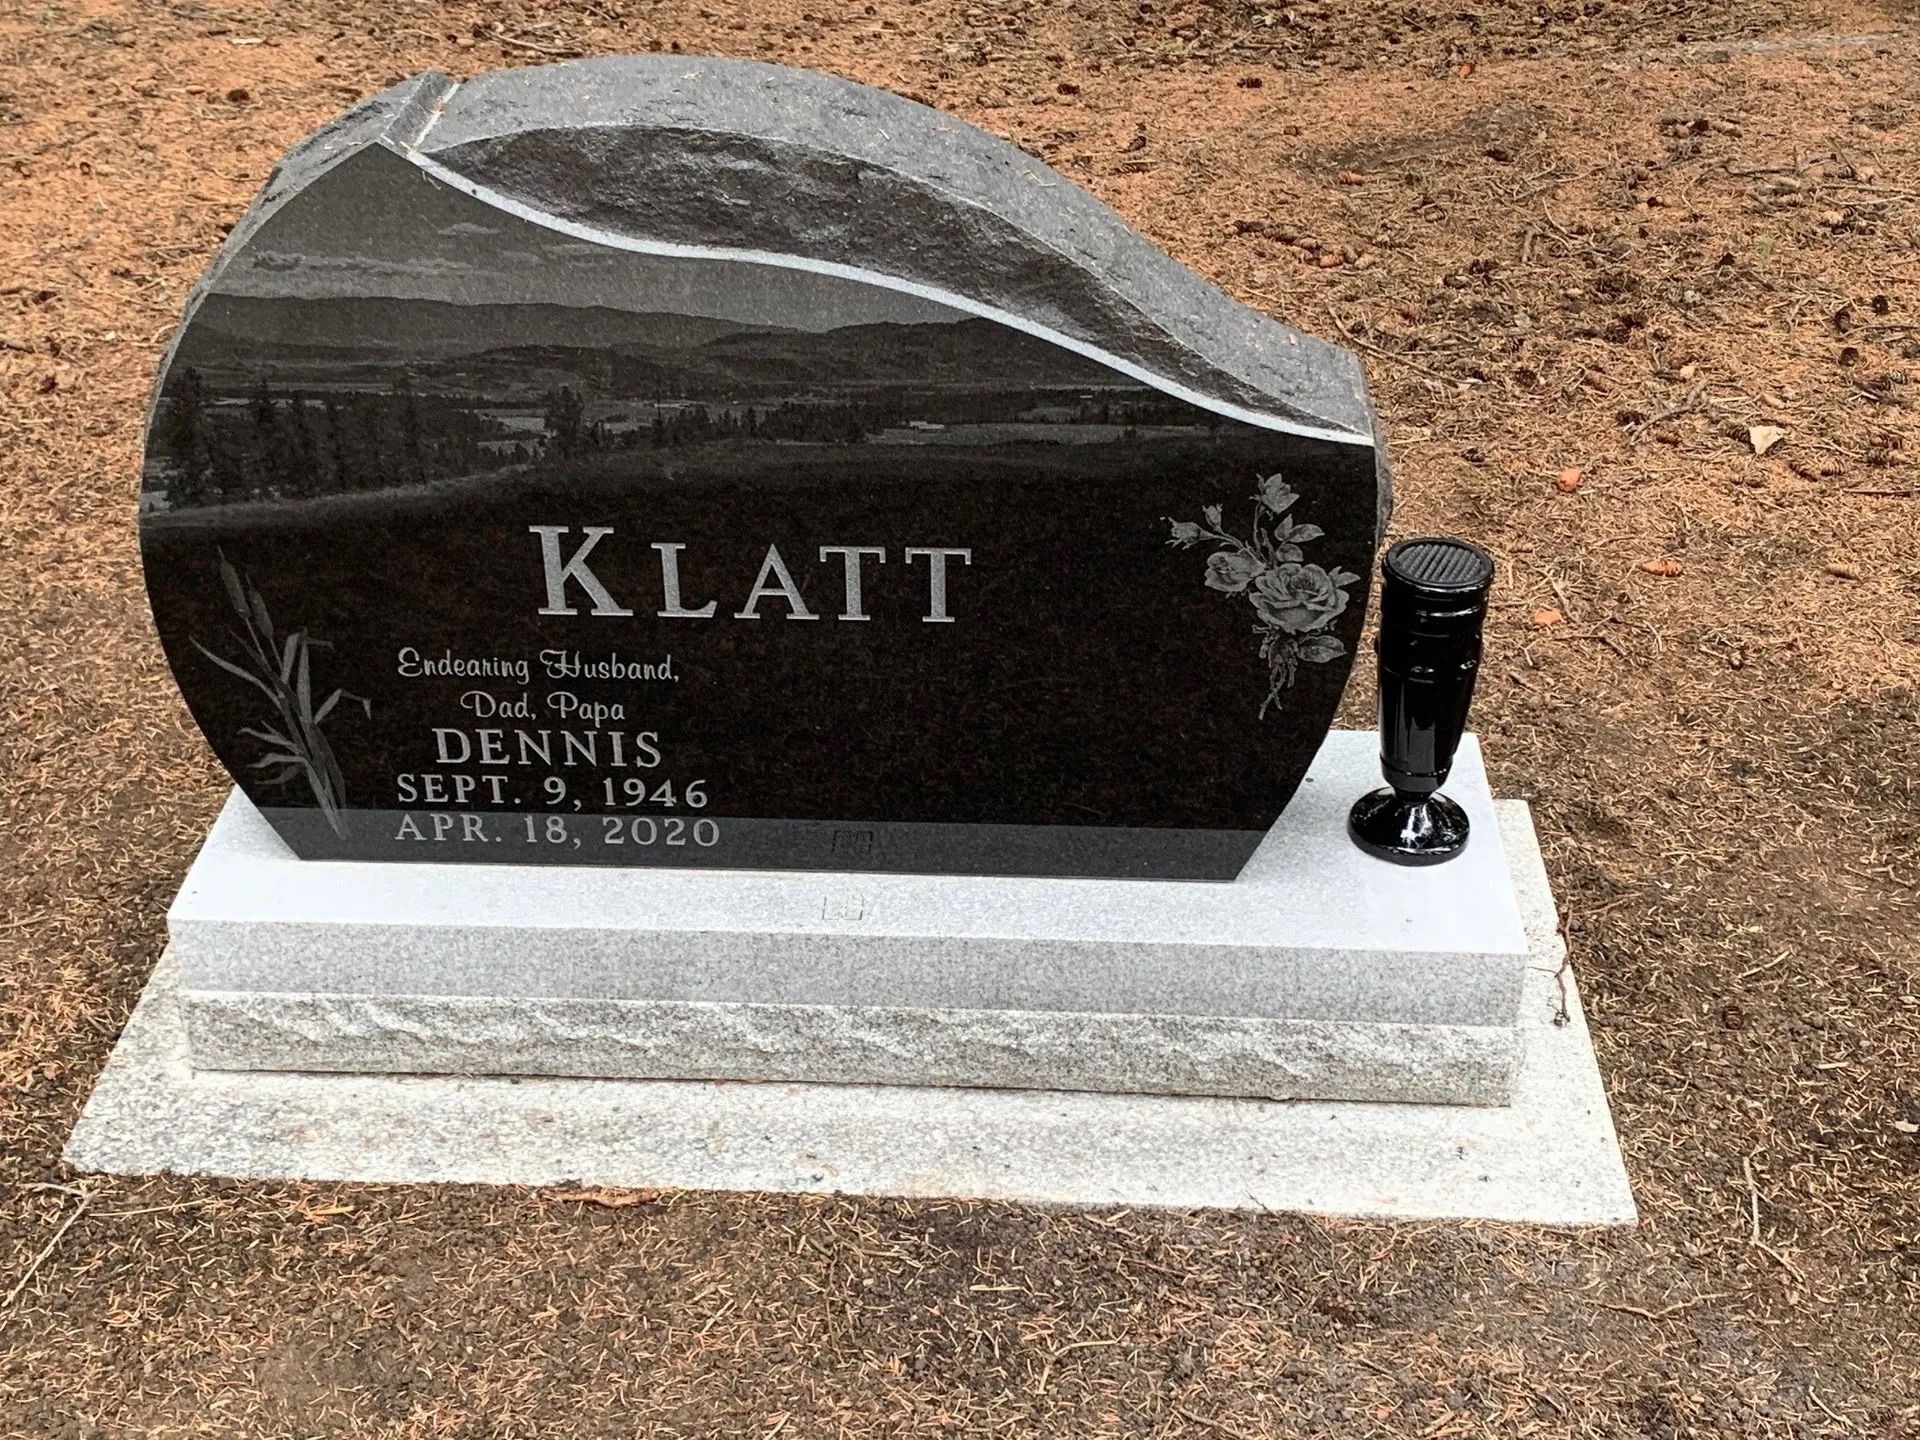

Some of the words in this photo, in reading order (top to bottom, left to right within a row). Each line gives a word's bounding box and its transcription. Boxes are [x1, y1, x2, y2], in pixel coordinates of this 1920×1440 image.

[529, 525, 972, 623] KLATT
[397, 647, 530, 685] Endearing
[539, 649, 680, 683] Husband,
[460, 690, 536, 721] Dad,
[546, 691, 625, 729] Papa
[432, 728, 661, 768] DENNIS
[397, 773, 522, 804] SEPT.
[543, 776, 582, 812] 9,
[603, 777, 708, 808] 1946
[394, 813, 502, 842] APR.
[524, 814, 581, 850] 18,
[602, 816, 720, 847] 2020
